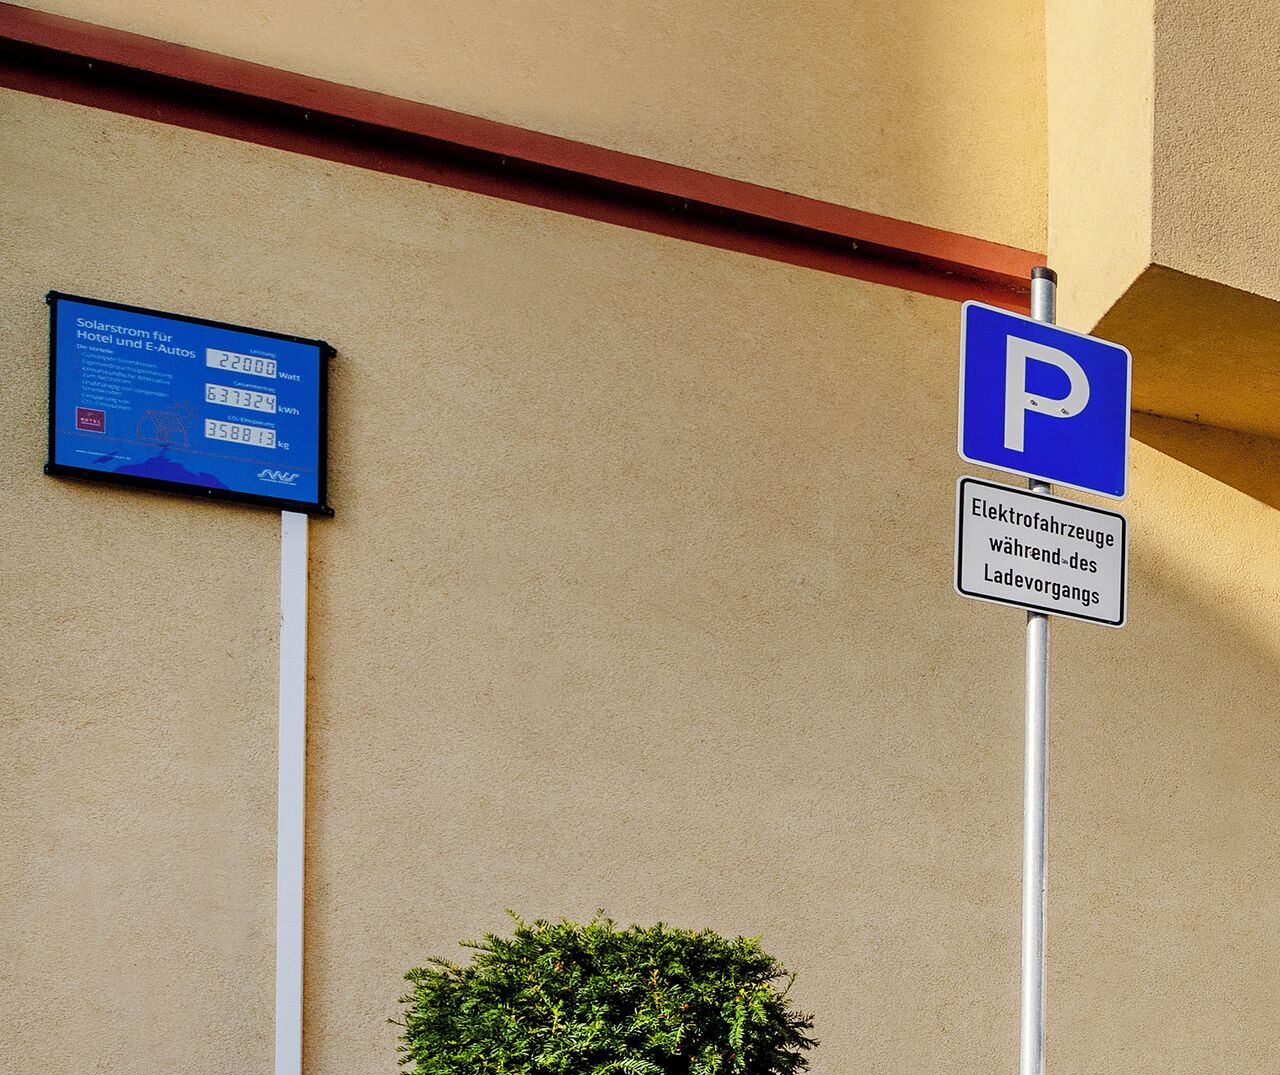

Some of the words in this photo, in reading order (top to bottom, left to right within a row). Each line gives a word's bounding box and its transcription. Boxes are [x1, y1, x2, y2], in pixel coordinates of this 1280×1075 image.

[76, 317, 150, 339] Solarstrom
[153, 330, 174, 343] für
[76, 329, 113, 344] Hotel
[116, 337, 143, 349] und
[145, 341, 197, 359] E-Autos
[219, 353, 276, 376] 22000
[278, 371, 301, 382] Watt
[207, 386, 275, 411] 637324
[278, 404, 300, 416] kWh
[1003, 334, 1090, 452] P
[207, 421, 275, 446] 358813
[277, 440, 290, 451] kg
[971, 497, 1115, 549] Elektrofahrzeuge
[989, 535, 1062, 567] während
[1069, 551, 1098, 574] des
[984, 562, 1100, 607] Ladevorgangs
